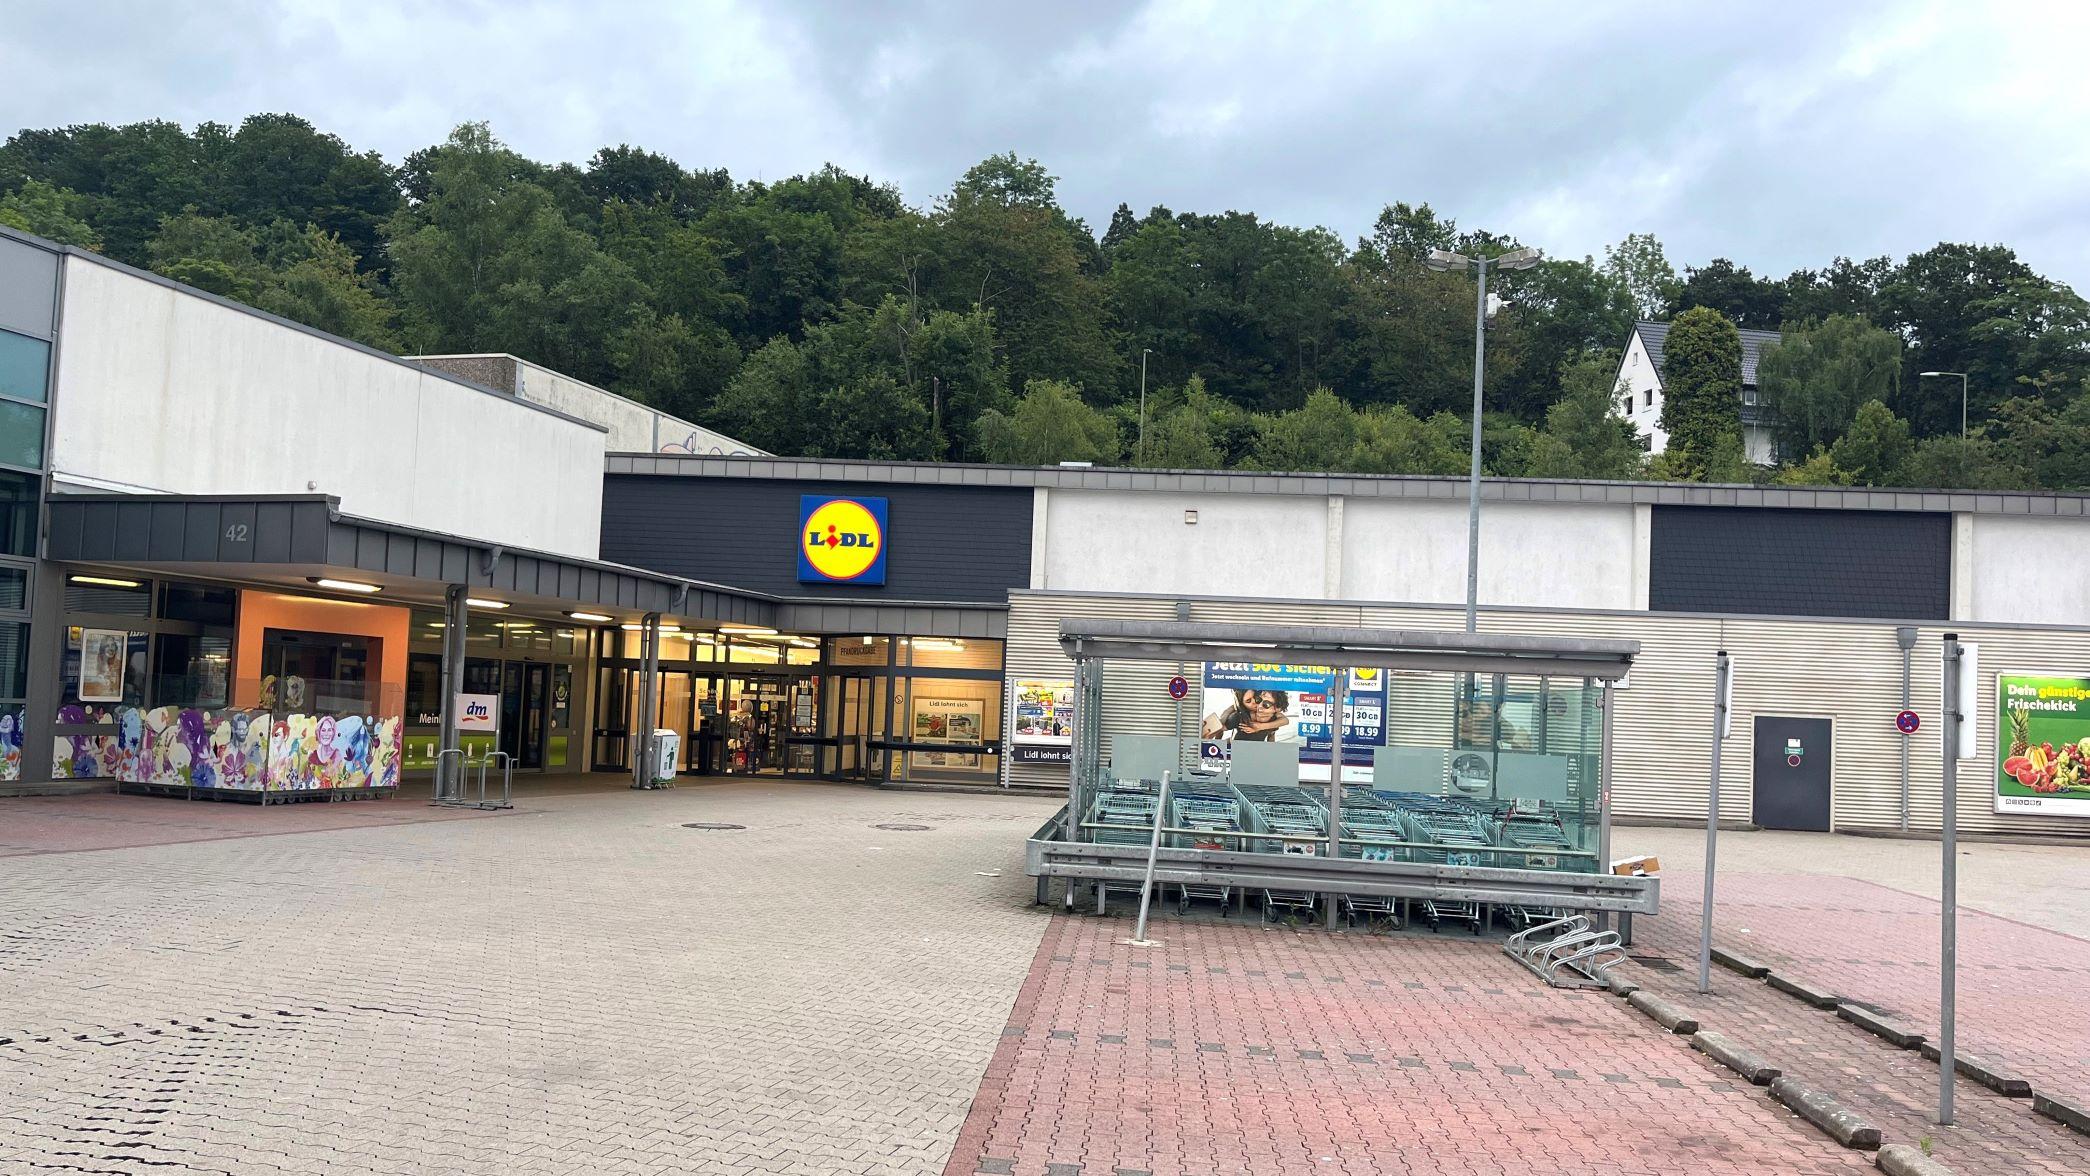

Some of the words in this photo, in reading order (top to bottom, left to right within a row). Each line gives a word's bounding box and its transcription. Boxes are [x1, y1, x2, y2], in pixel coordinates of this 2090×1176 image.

[226, 525, 247, 541] 42
[2007, 684, 2037, 696] Dein
[466, 702, 487, 716] dm
[2007, 698, 2077, 712] Frischekick
[1302, 708, 1312, 717] 10
[1356, 711, 1367, 719] 30
[1302, 724, 1320, 734] 8.99
[1355, 727, 1378, 737] 18.99
[1024, 751, 1039, 759] Lidl
[1040, 751, 1061, 760] lohnt
[1062, 752, 1072, 760] sic
